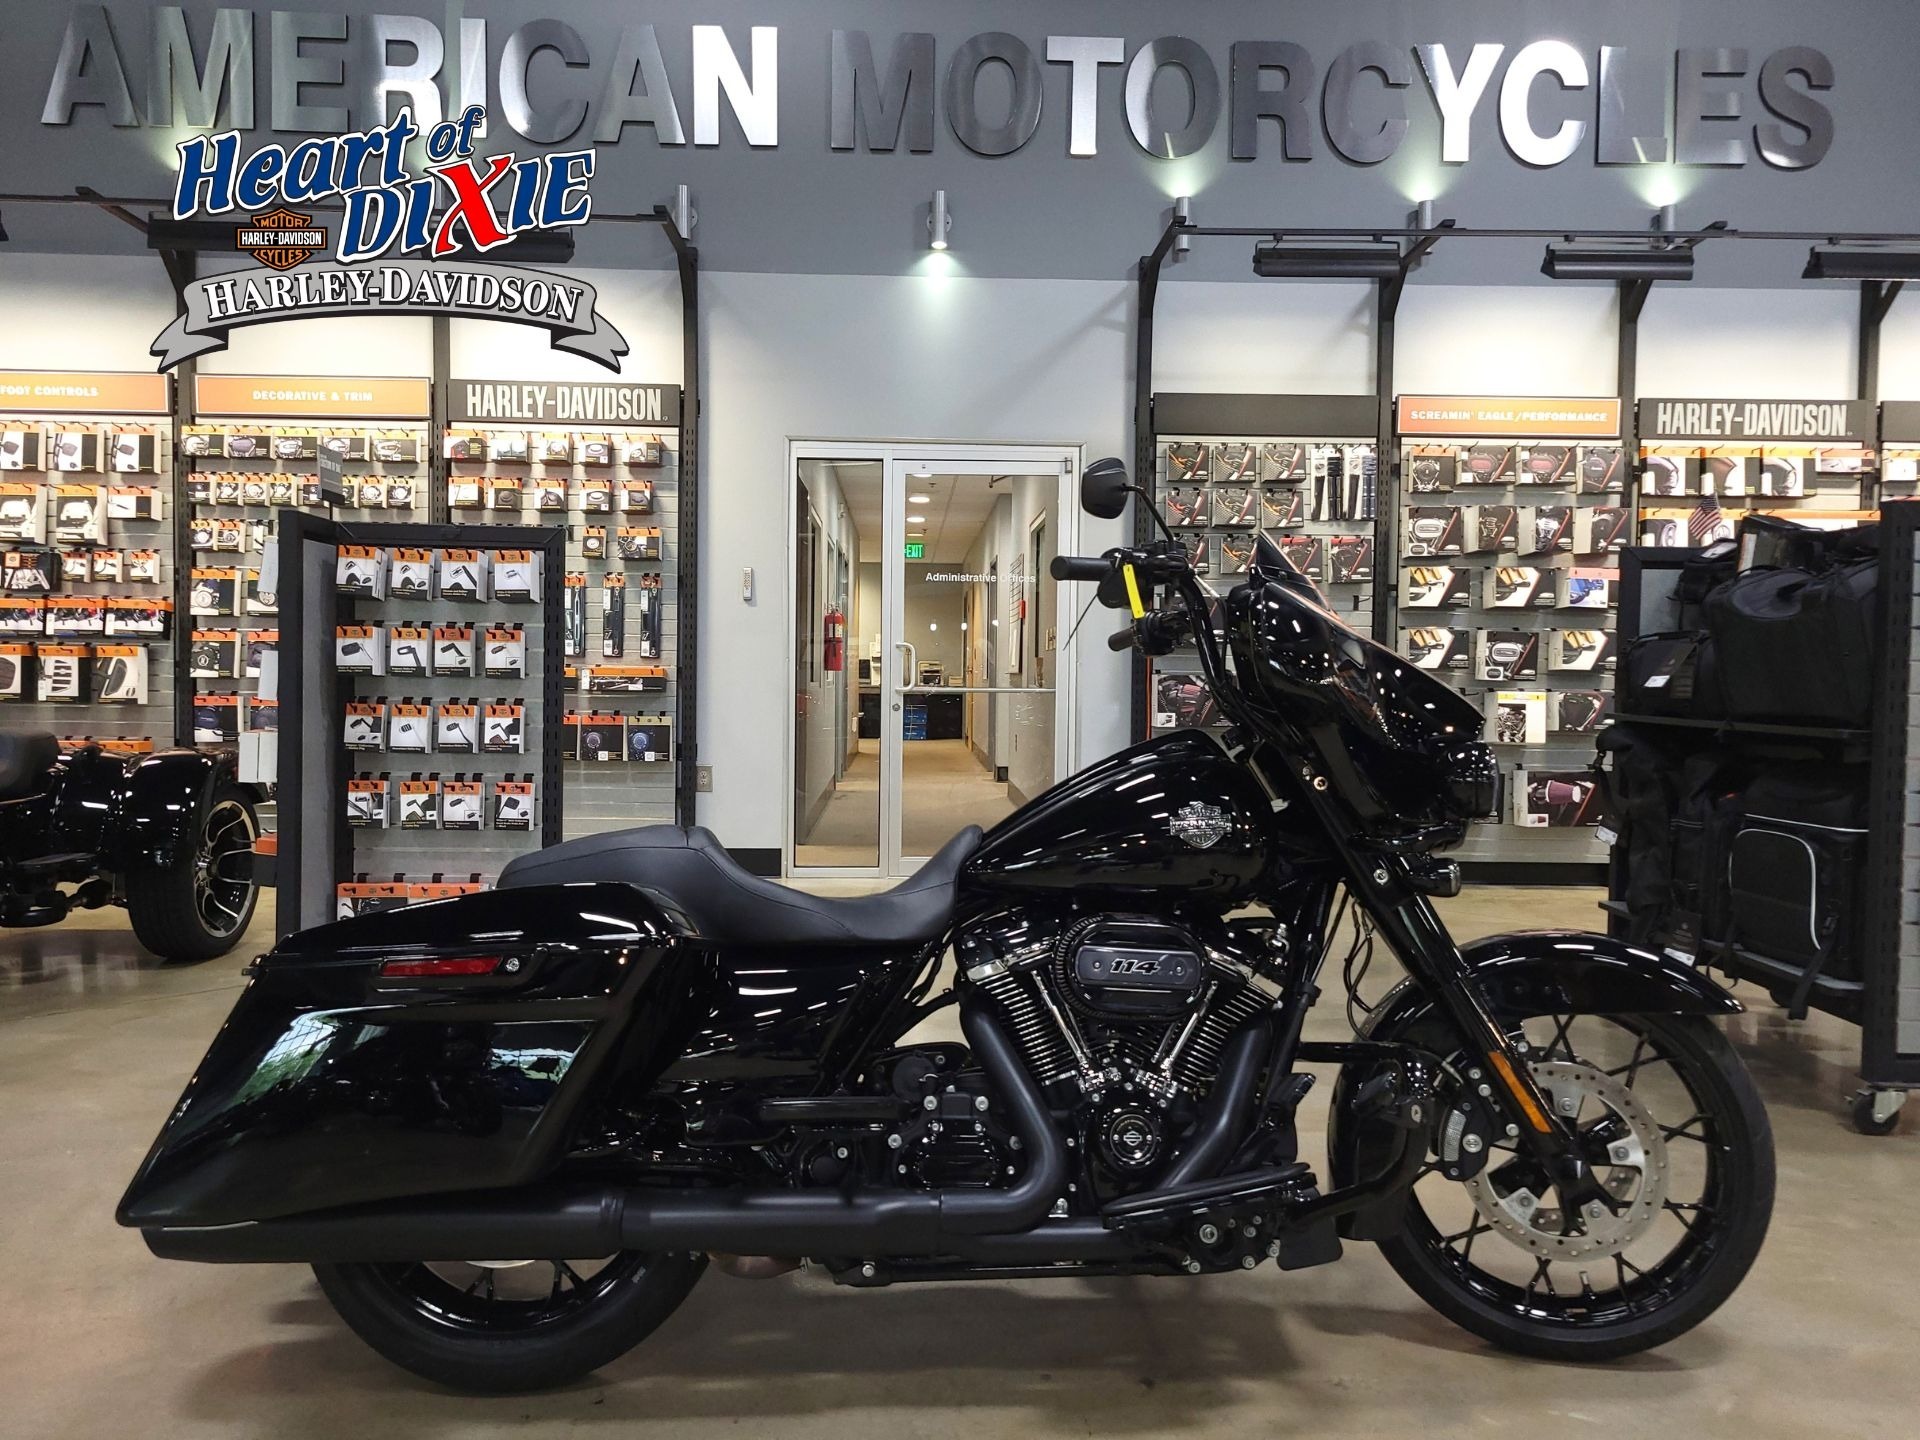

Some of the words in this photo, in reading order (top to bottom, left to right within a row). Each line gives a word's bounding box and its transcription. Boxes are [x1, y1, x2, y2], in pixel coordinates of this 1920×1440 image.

[41, 6, 778, 148] AMERICAN
[830, 28, 1836, 170] MOTORCYCLES
[0, 385, 31, 396] FOOT
[34, 386, 98, 397] CONTROLS
[252, 390, 327, 401] DECORATIVE
[344, 391, 373, 401] TRIM
[466, 384, 662, 421] HARLEY-DAVIDSON
[1410, 410, 1475, 421] SCREAMIN'
[1656, 402, 1847, 437] HARLEY-DAVIDSON
[906, 544, 923, 558] EXIT
[925, 572, 997, 583] Administrative
[1110, 958, 1161, 975] 114
